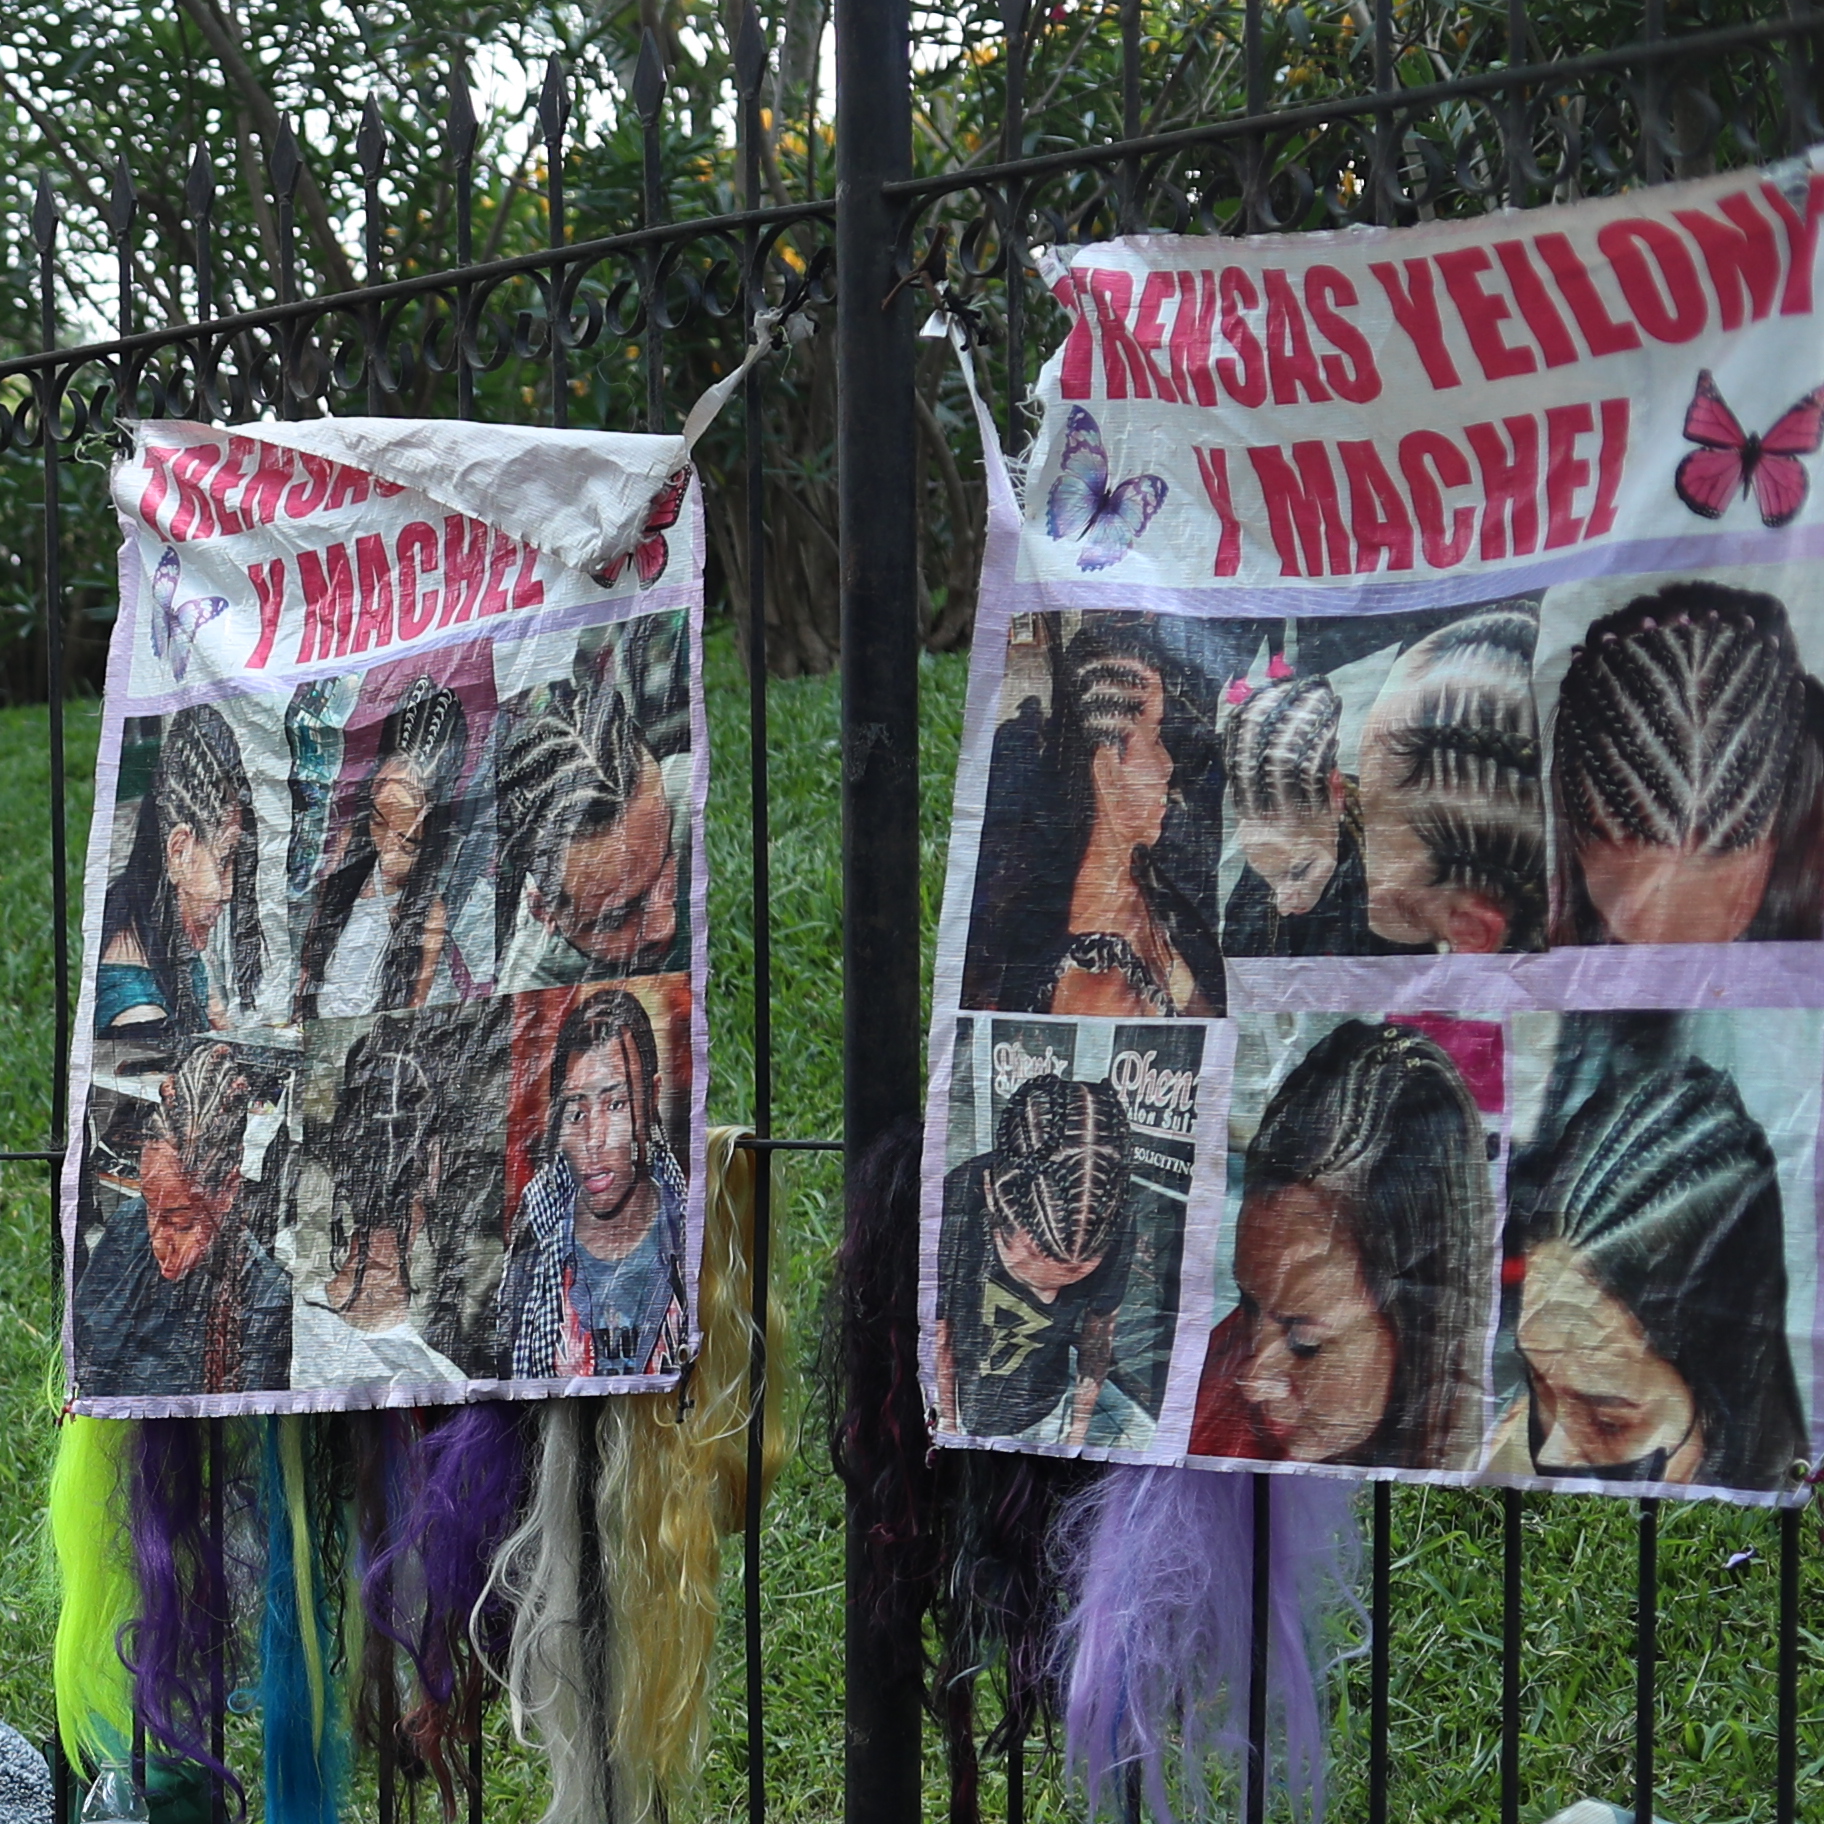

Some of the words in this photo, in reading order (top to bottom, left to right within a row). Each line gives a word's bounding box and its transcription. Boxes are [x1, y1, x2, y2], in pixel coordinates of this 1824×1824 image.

[1052, 265, 1383, 409] TRENSAS
[1369, 174, 1824, 390] YEILONY
[140, 434, 407, 542] TRENSA
[1194, 447, 1241, 577] Y
[245, 557, 286, 669] Y
[296, 513, 545, 664] MACHEL
[1111, 1050, 1198, 1112] Phen
[1161, 1108, 1197, 1134] Sui
